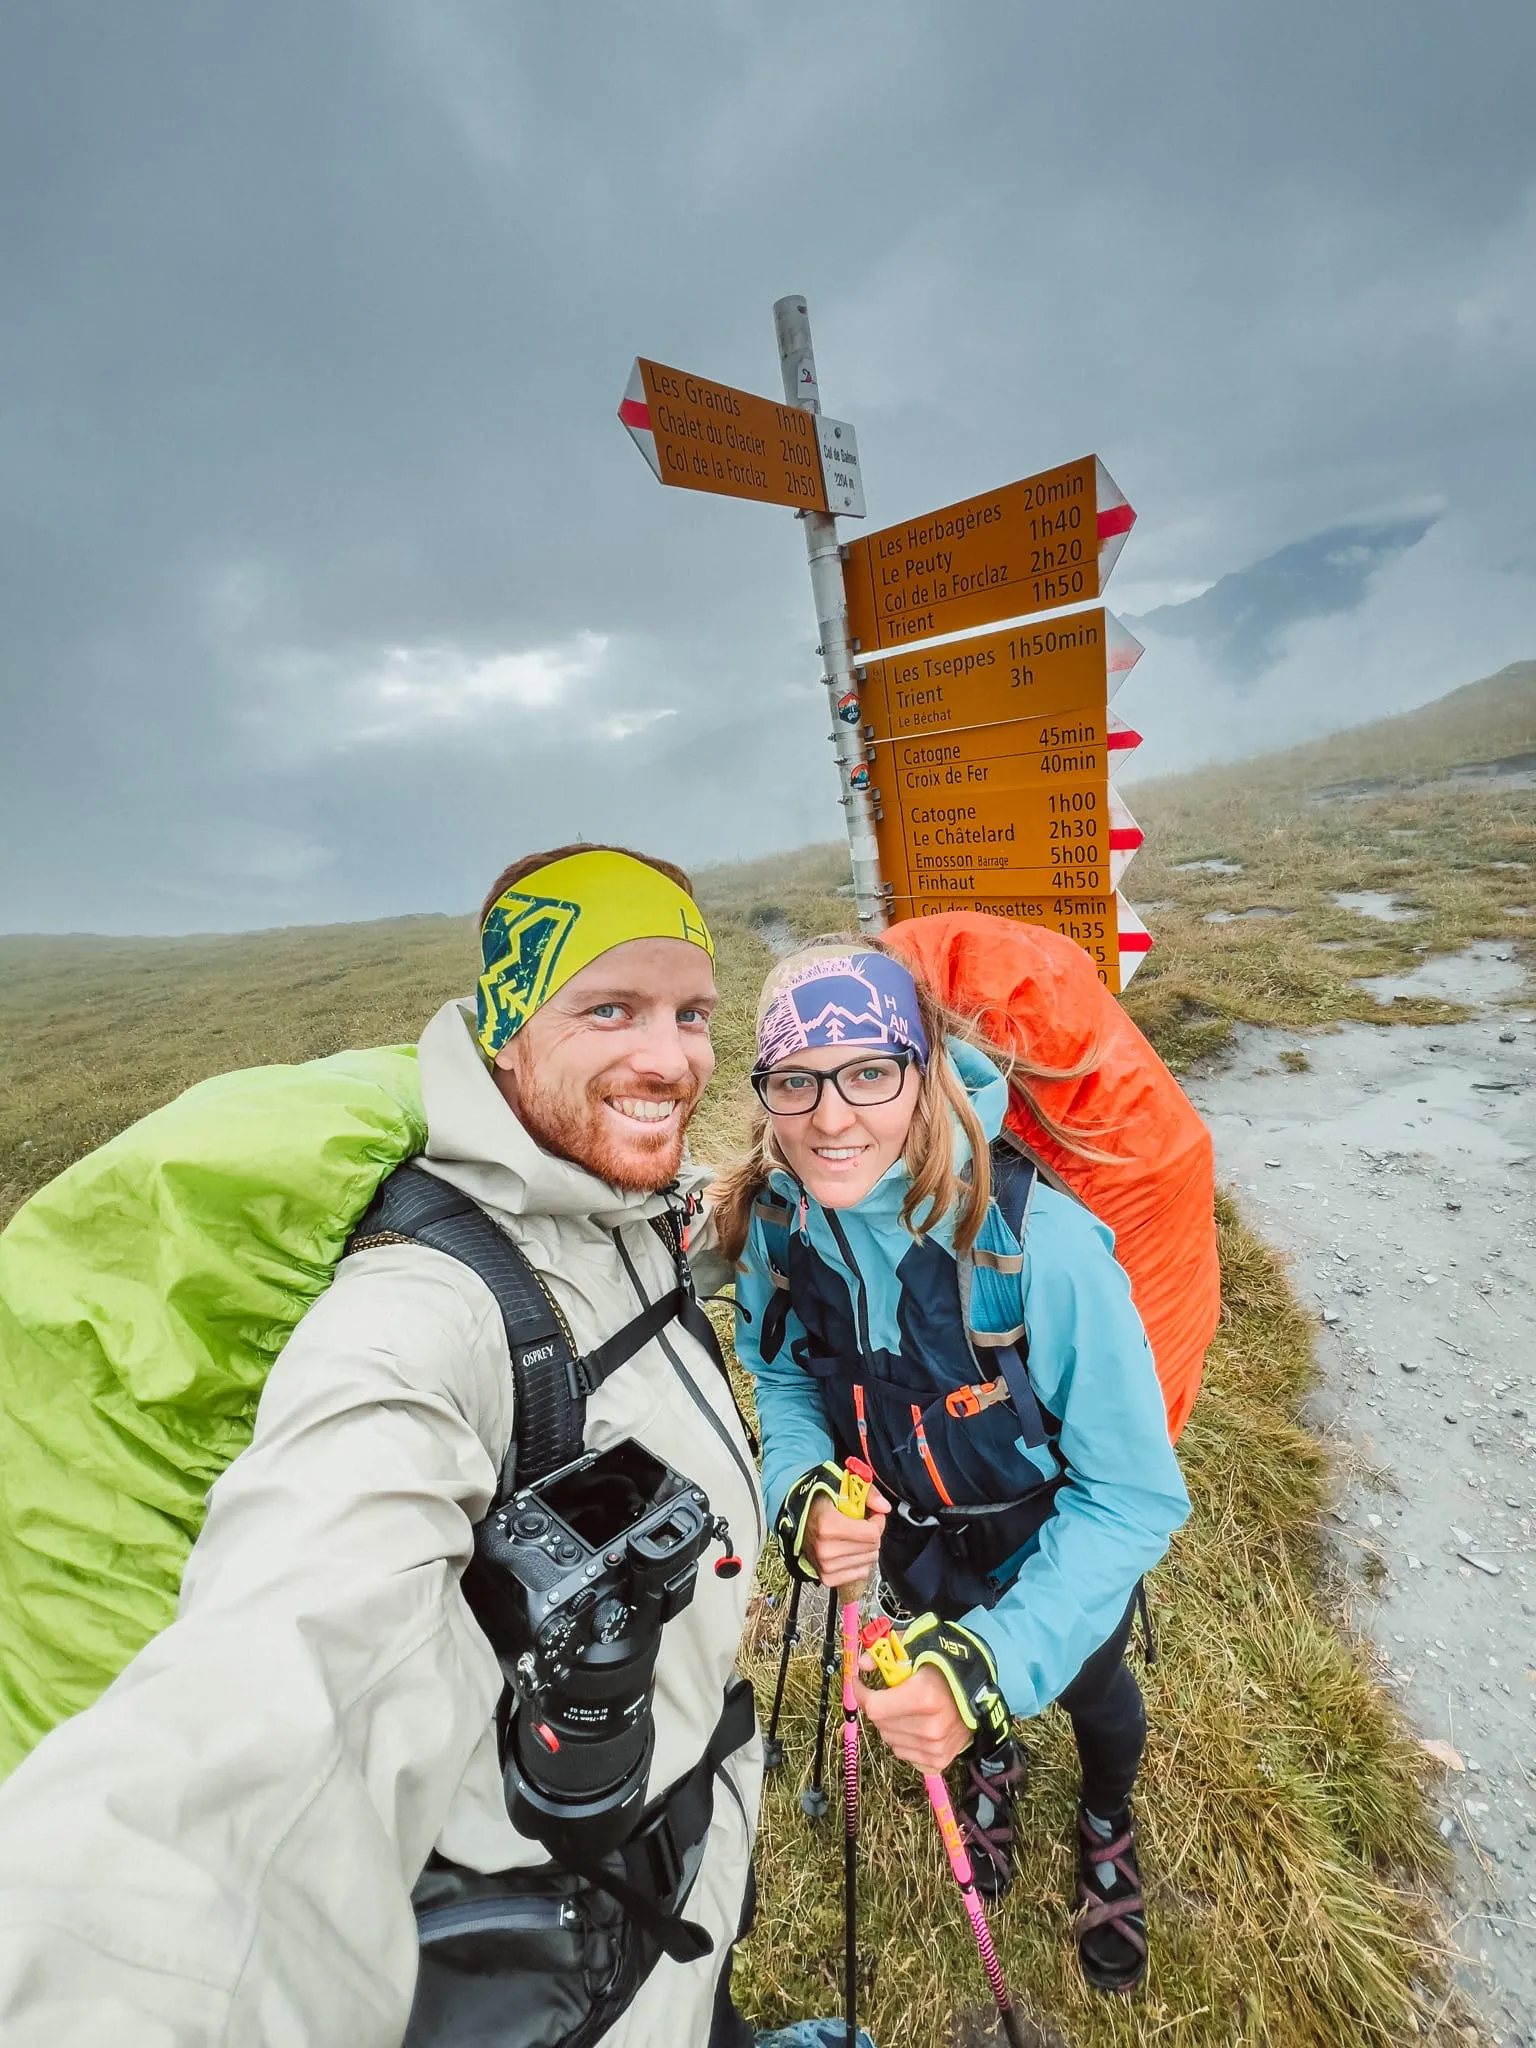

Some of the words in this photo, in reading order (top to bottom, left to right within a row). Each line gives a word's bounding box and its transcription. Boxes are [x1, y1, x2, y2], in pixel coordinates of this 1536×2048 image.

[650, 366, 680, 399] Les
[685, 378, 741, 417] Grands
[776, 407, 806, 436] 1h10
[658, 406, 702, 441] Chalet
[706, 423, 723, 445] du
[726, 424, 766, 456] Glacier
[780, 439, 811, 467] 2h00
[666, 444, 687, 473] Col
[693, 453, 709, 477] de
[713, 460, 724, 480] la
[727, 458, 768, 489] Forclaz
[785, 471, 816, 498] 2h50
[879, 537, 902, 560] Les
[907, 504, 1002, 548] Herbagères
[1024, 473, 1084, 511] 20min
[882, 566, 899, 586] Le
[905, 551, 952, 579] Peuty
[1029, 506, 1082, 542] 1h40
[884, 587, 907, 613] Col
[911, 586, 928, 607] de
[934, 580, 947, 601] la
[952, 564, 1008, 595] Forclaz
[1030, 539, 1082, 574] 2h20
[887, 612, 935, 639] Trient
[1032, 571, 1083, 603] 1h50
[894, 666, 919, 684] Les
[923, 648, 996, 680] Tseppes
[1008, 626, 1098, 661] 1h50min
[896, 685, 944, 709] Trient
[1010, 666, 1034, 688] 3h
[898, 716, 910, 728] Le
[914, 708, 952, 726] Béchat
[903, 745, 961, 767] Catogne
[1039, 725, 1095, 748] 45min
[906, 769, 940, 789] Croix
[945, 766, 962, 785] de
[967, 765, 989, 782] Fer
[1040, 752, 1096, 774] 40min
[911, 804, 976, 825] Catogne
[1048, 791, 1096, 814] 1h00
[913, 830, 929, 847] Le
[935, 823, 1015, 846] Châtelard
[1049, 818, 1097, 839] 2h30
[915, 852, 973, 869] Emosson
[977, 854, 1009, 869] Barrage
[1051, 844, 1098, 865] 5h00
[918, 873, 975, 891] Finhaut
[1051, 870, 1099, 889] 4h50
[975, 901, 1044, 917] Possettes
[1053, 898, 1107, 917] 45min
[1059, 922, 1104, 939] 1h35
[522, 1345, 554, 1367] OSPREY
[939, 1635, 969, 1660] LEKI
